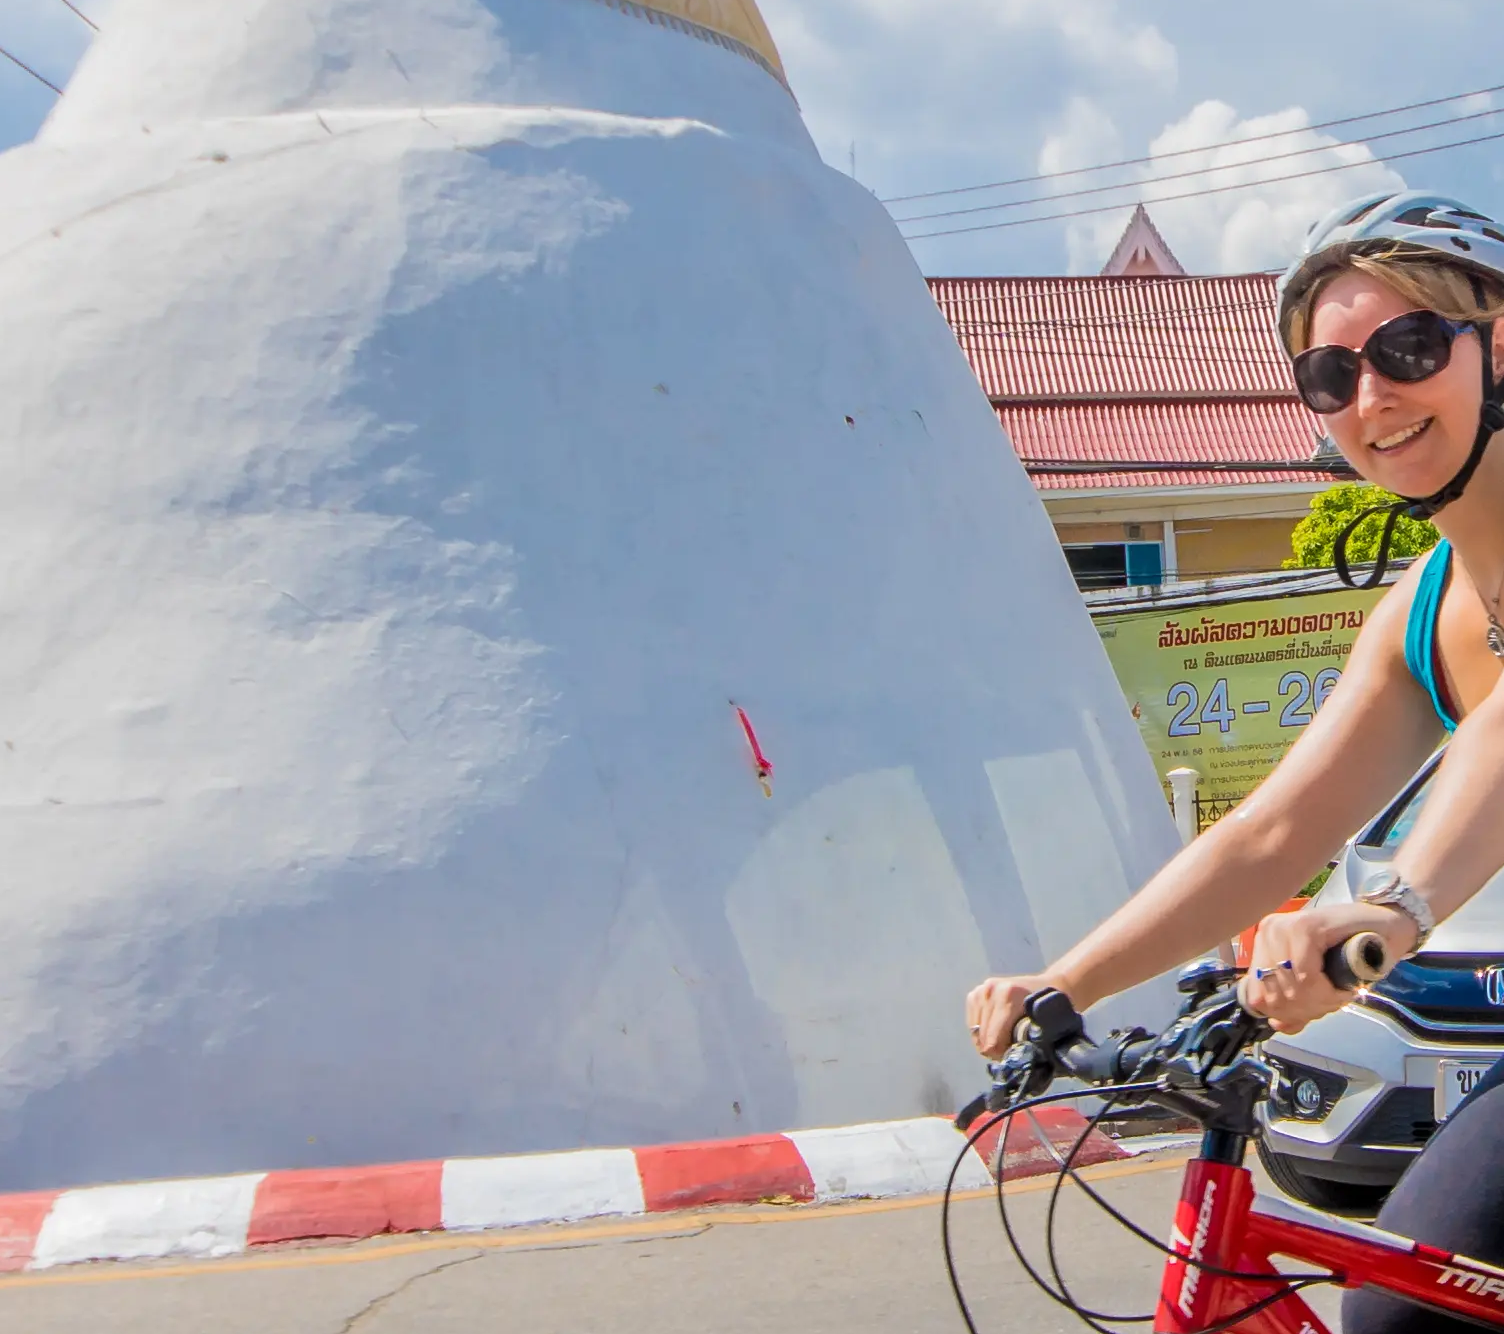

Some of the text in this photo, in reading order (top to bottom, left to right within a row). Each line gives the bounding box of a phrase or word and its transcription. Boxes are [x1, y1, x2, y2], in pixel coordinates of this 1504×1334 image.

[1158, 610, 1364, 648] สัมผัสความงดงาม
[1167, 678, 1235, 737] 24
[1457, 1070, 1481, 1094] ข
